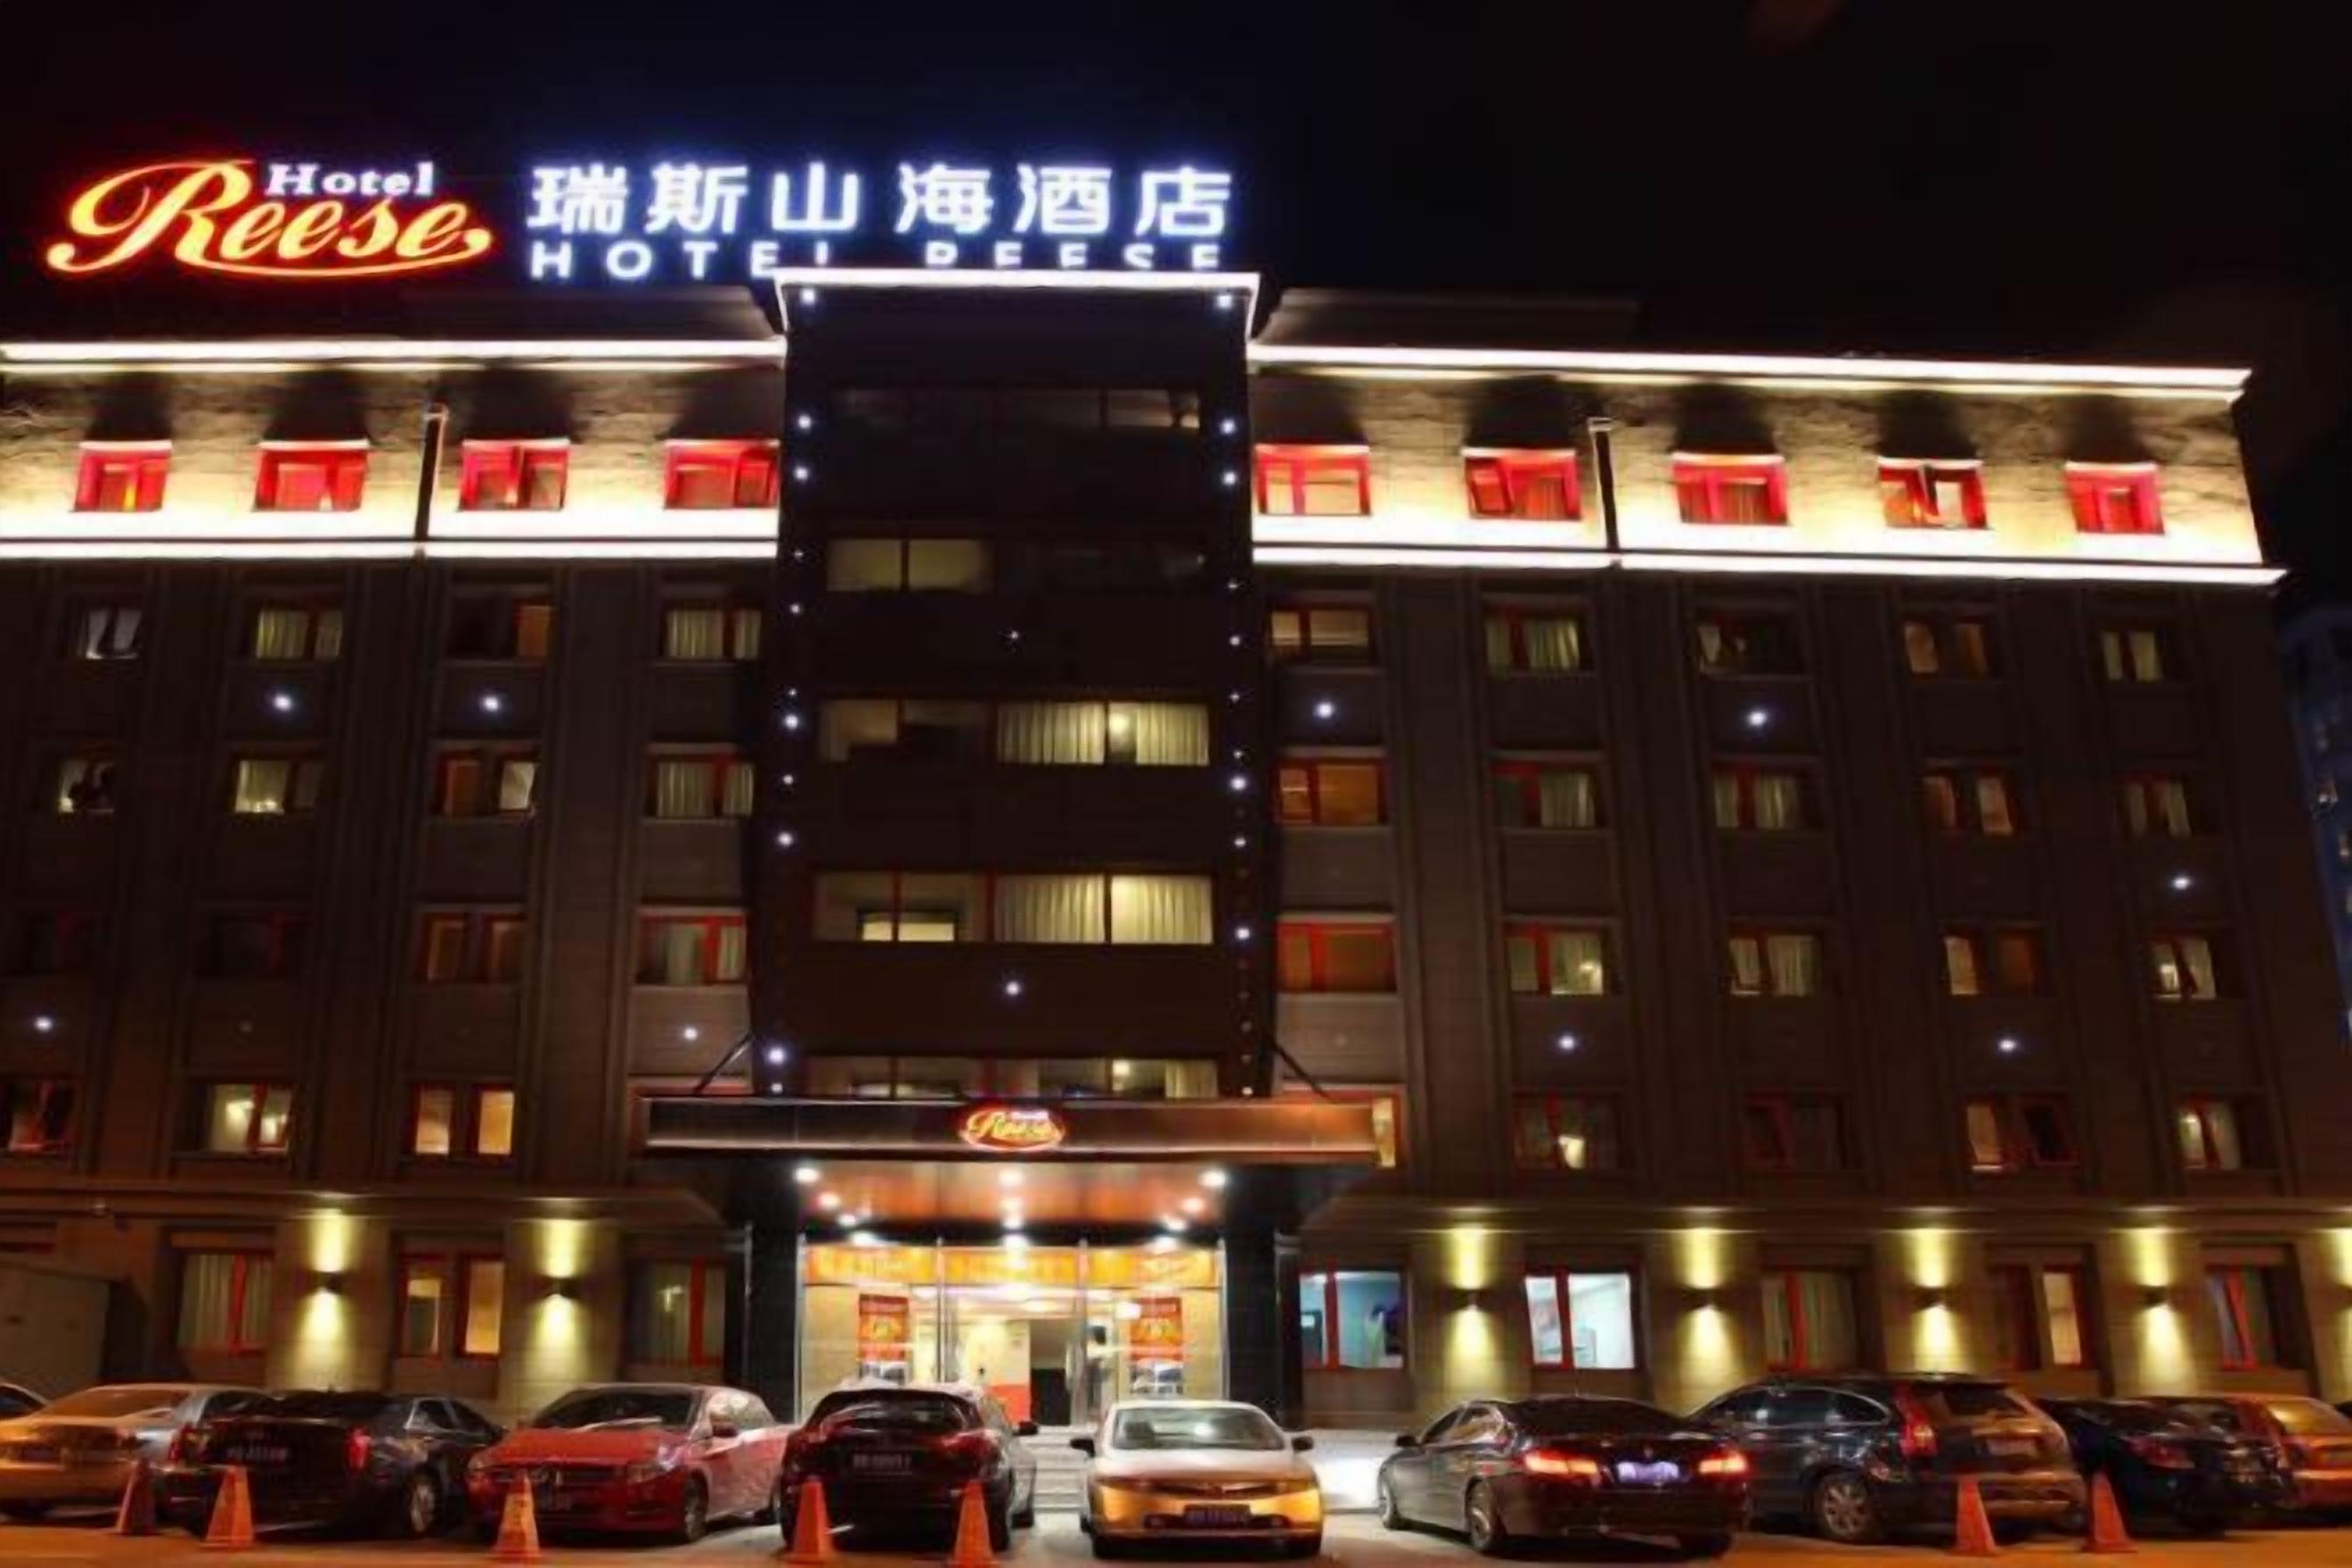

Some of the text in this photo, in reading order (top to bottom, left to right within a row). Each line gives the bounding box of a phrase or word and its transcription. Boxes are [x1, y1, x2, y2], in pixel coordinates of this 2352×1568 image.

[267, 160, 434, 196] Hotel
[527, 161, 1232, 235] 瑞斯山海酒店
[46, 159, 491, 276] Reese
